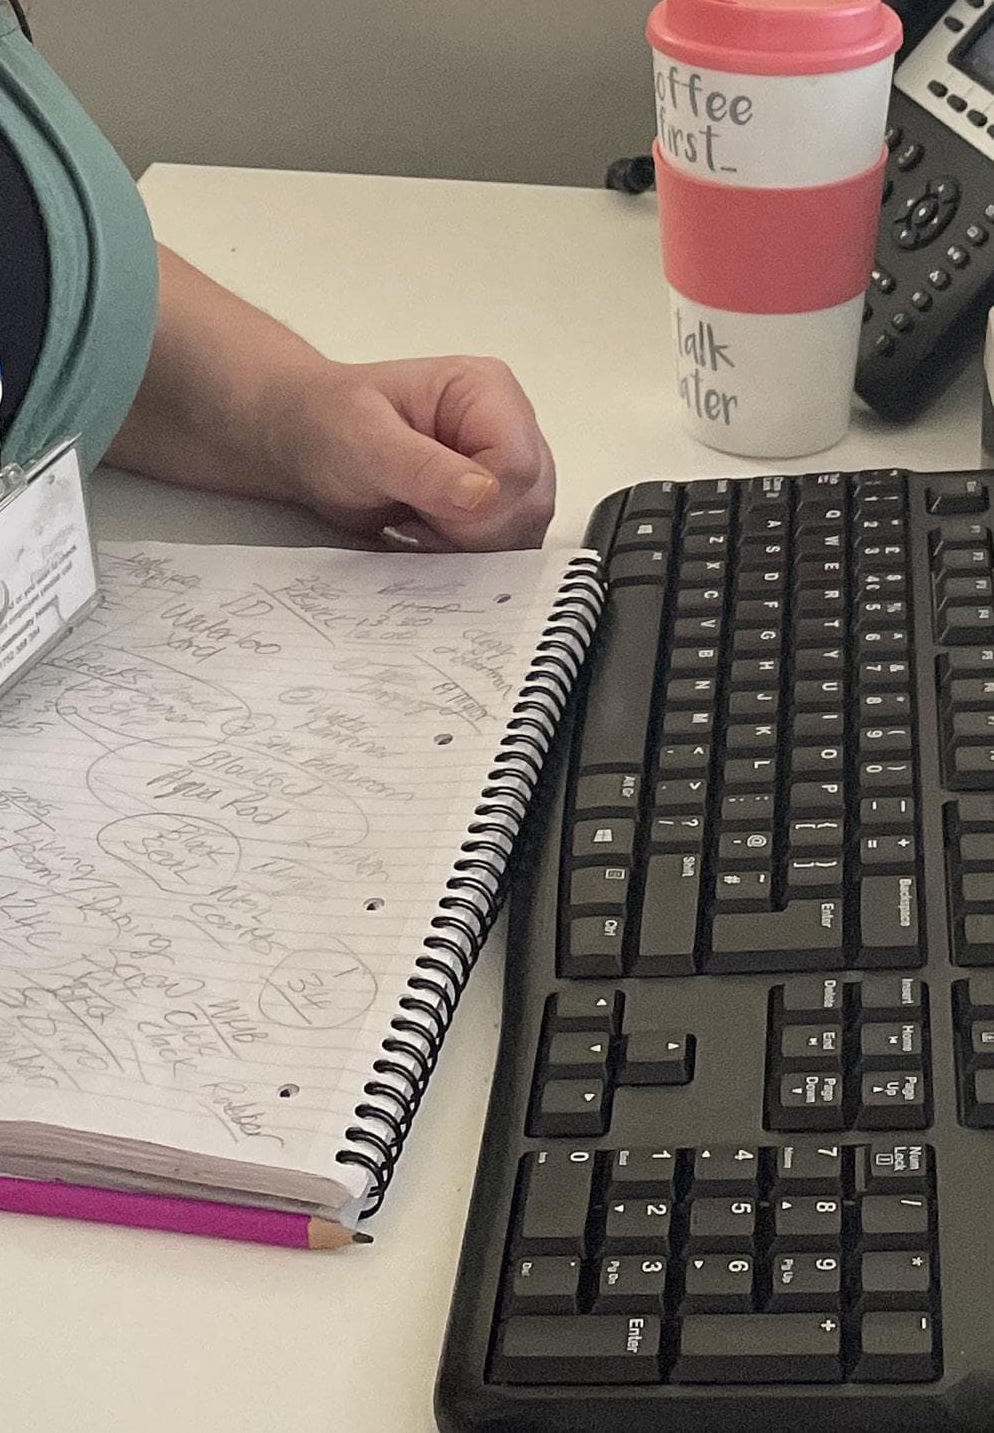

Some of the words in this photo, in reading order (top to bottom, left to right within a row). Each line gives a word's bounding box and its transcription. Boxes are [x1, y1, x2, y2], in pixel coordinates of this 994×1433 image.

[657, 66, 753, 126] offee
[679, 368, 738, 426] ater
[826, 510, 841, 518] Q
[825, 536, 839, 545] W
[825, 590, 839, 598] R
[761, 631, 776, 639] G
[760, 661, 774, 669] H
[695, 681, 710, 689] N
[822, 682, 837, 690] U
[756, 727, 771, 735] K
[822, 903, 834, 927] Enter
[571, 1152, 589, 1161] 0
[735, 1150, 753, 1160] 4
[818, 1147, 837, 1156] 7
[890, 1147, 906, 1170] Lock
[910, 1147, 921, 1169] Num
[648, 1205, 666, 1215] 2
[732, 1203, 751, 1213] 5
[817, 1202, 836, 1212] 8
[643, 1262, 662, 1272] 3
[729, 1261, 748, 1271] 6
[816, 1259, 836, 1269] 9
[628, 1319, 643, 1352] Enter
